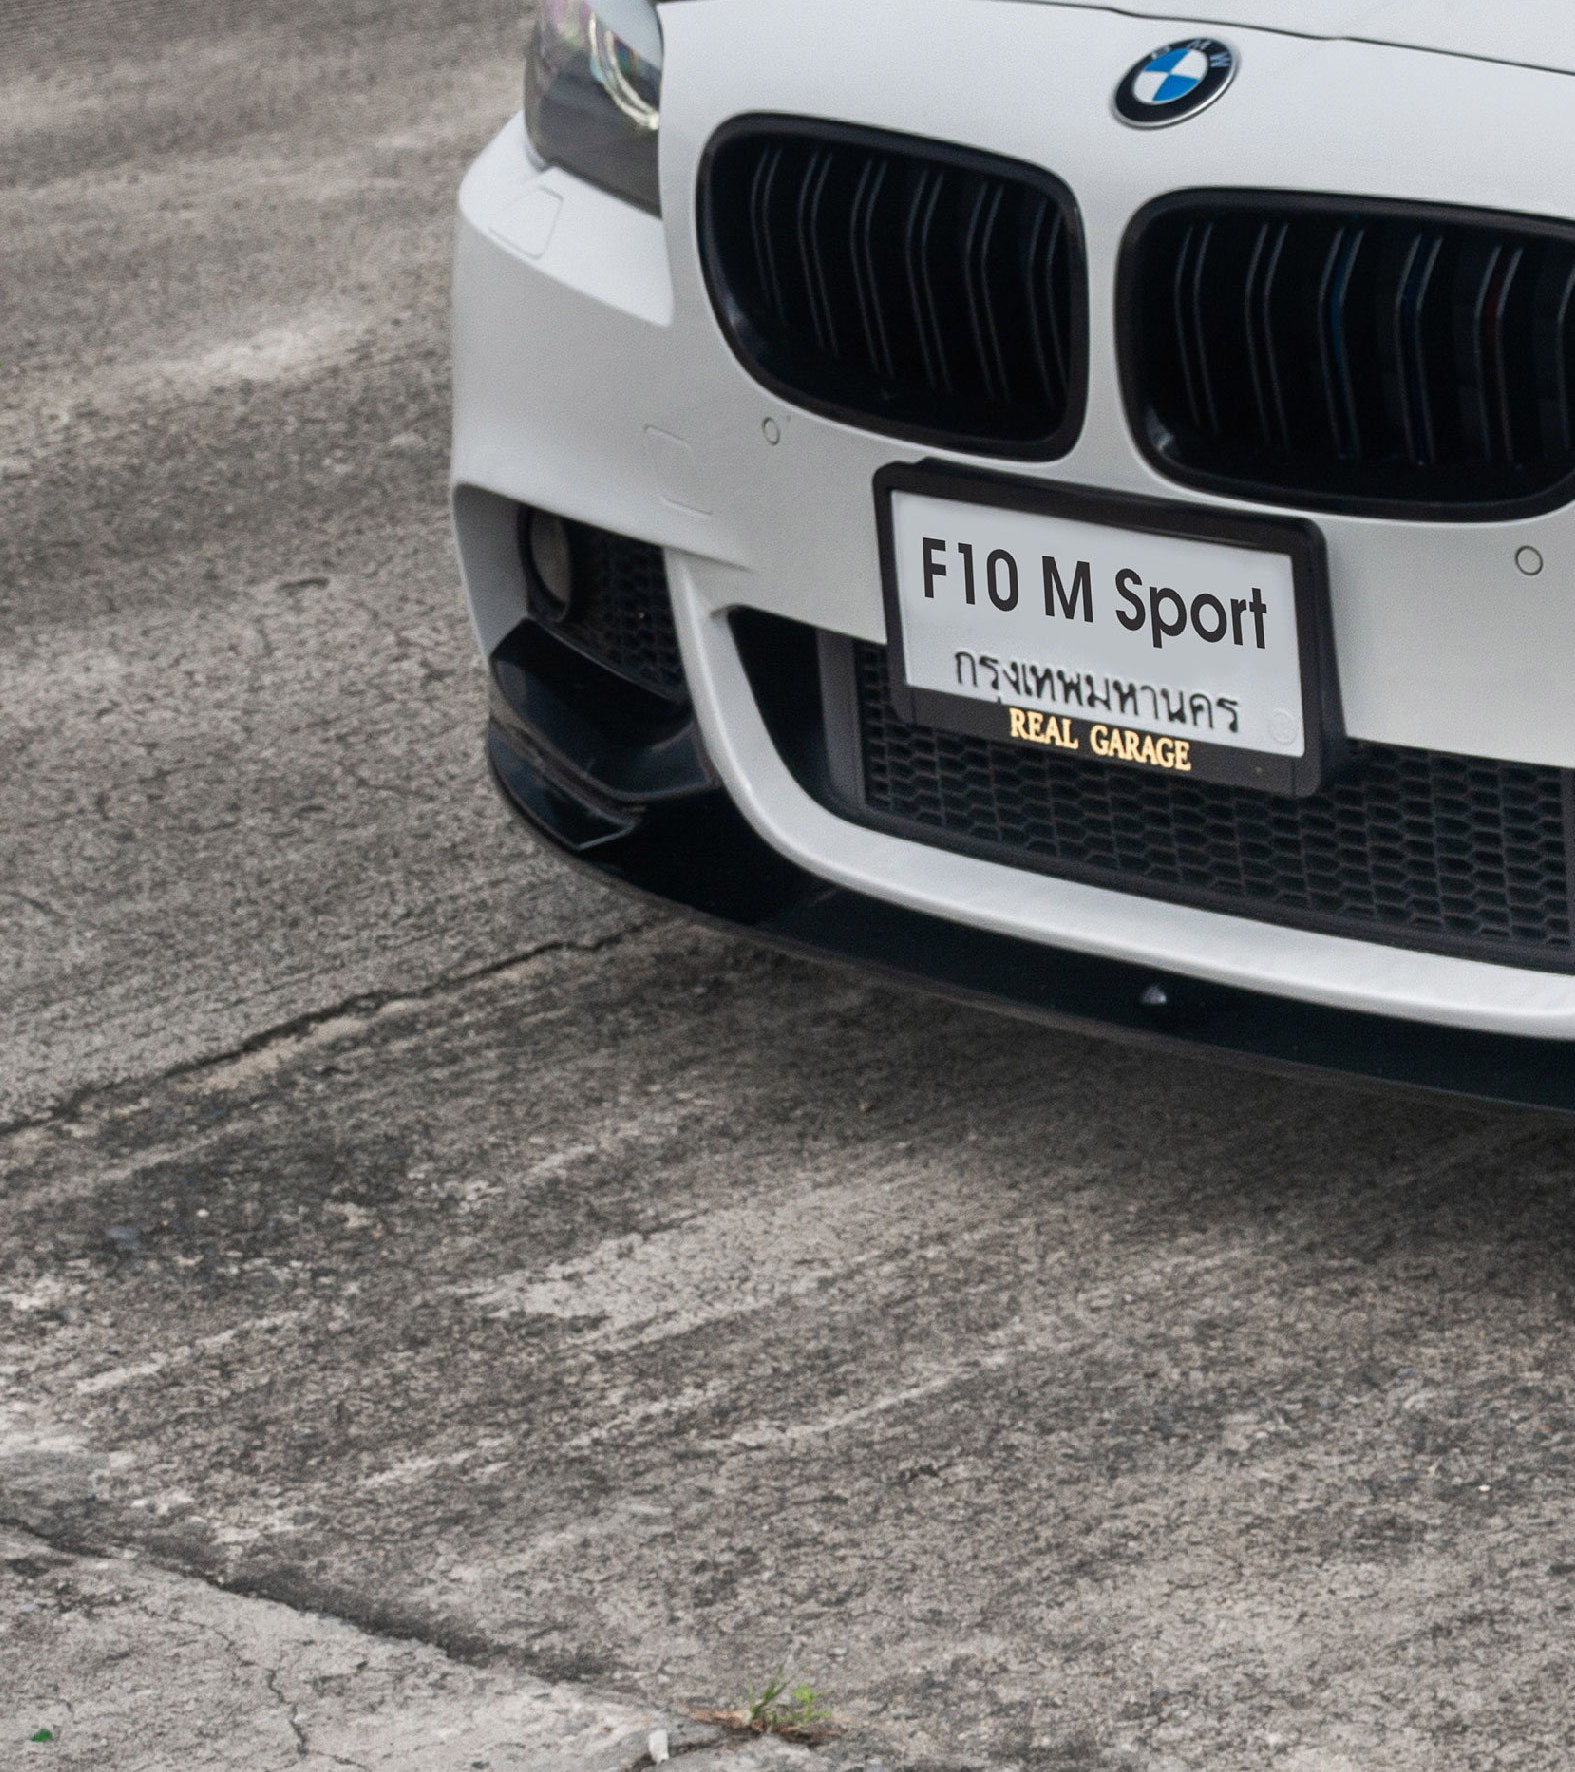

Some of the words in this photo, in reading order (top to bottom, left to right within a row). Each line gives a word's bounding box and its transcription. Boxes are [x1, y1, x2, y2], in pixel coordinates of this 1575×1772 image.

[922, 536, 1019, 612] F10
[1041, 555, 1094, 623] M
[1115, 568, 1267, 649] Sport
[954, 651, 1240, 733] กรงเทพมหานคร
[1009, 707, 1079, 750] REAL
[1090, 725, 1192, 771] GARAGE
